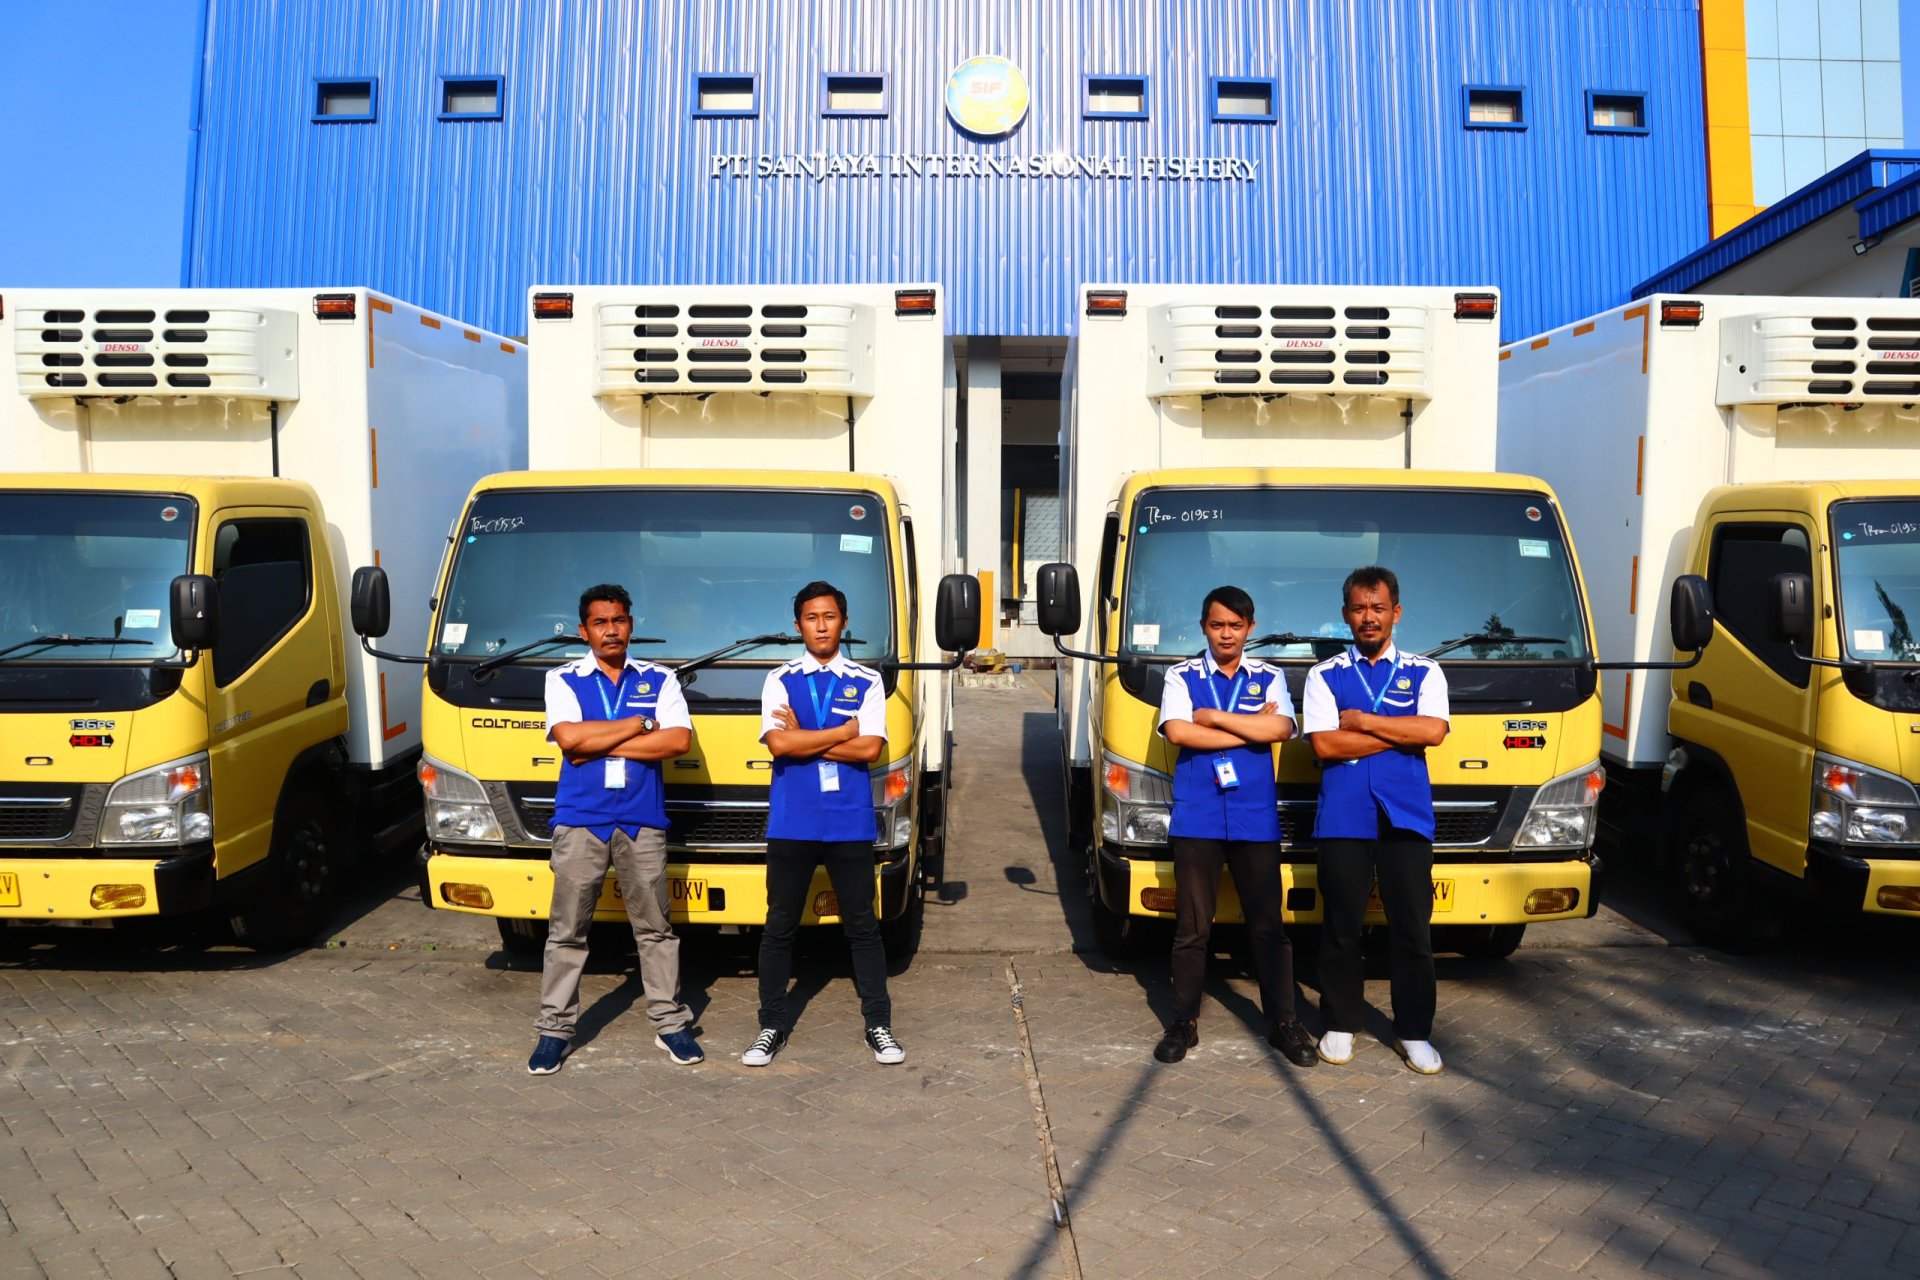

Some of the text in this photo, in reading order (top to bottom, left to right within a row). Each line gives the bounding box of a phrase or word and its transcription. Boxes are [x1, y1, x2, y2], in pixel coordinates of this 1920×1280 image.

[971, 81, 1003, 95] SIF
[711, 153, 1260, 182] PT. SANJAYA INTERNASIONAL FISHERY
[104, 343, 139, 352] DENSO
[702, 339, 738, 347] DENSO
[1286, 340, 1323, 348] DENSO
[1883, 351, 1919, 360] DENSO
[69, 719, 115, 730] 136PS
[1503, 720, 1547, 731] 136PS
